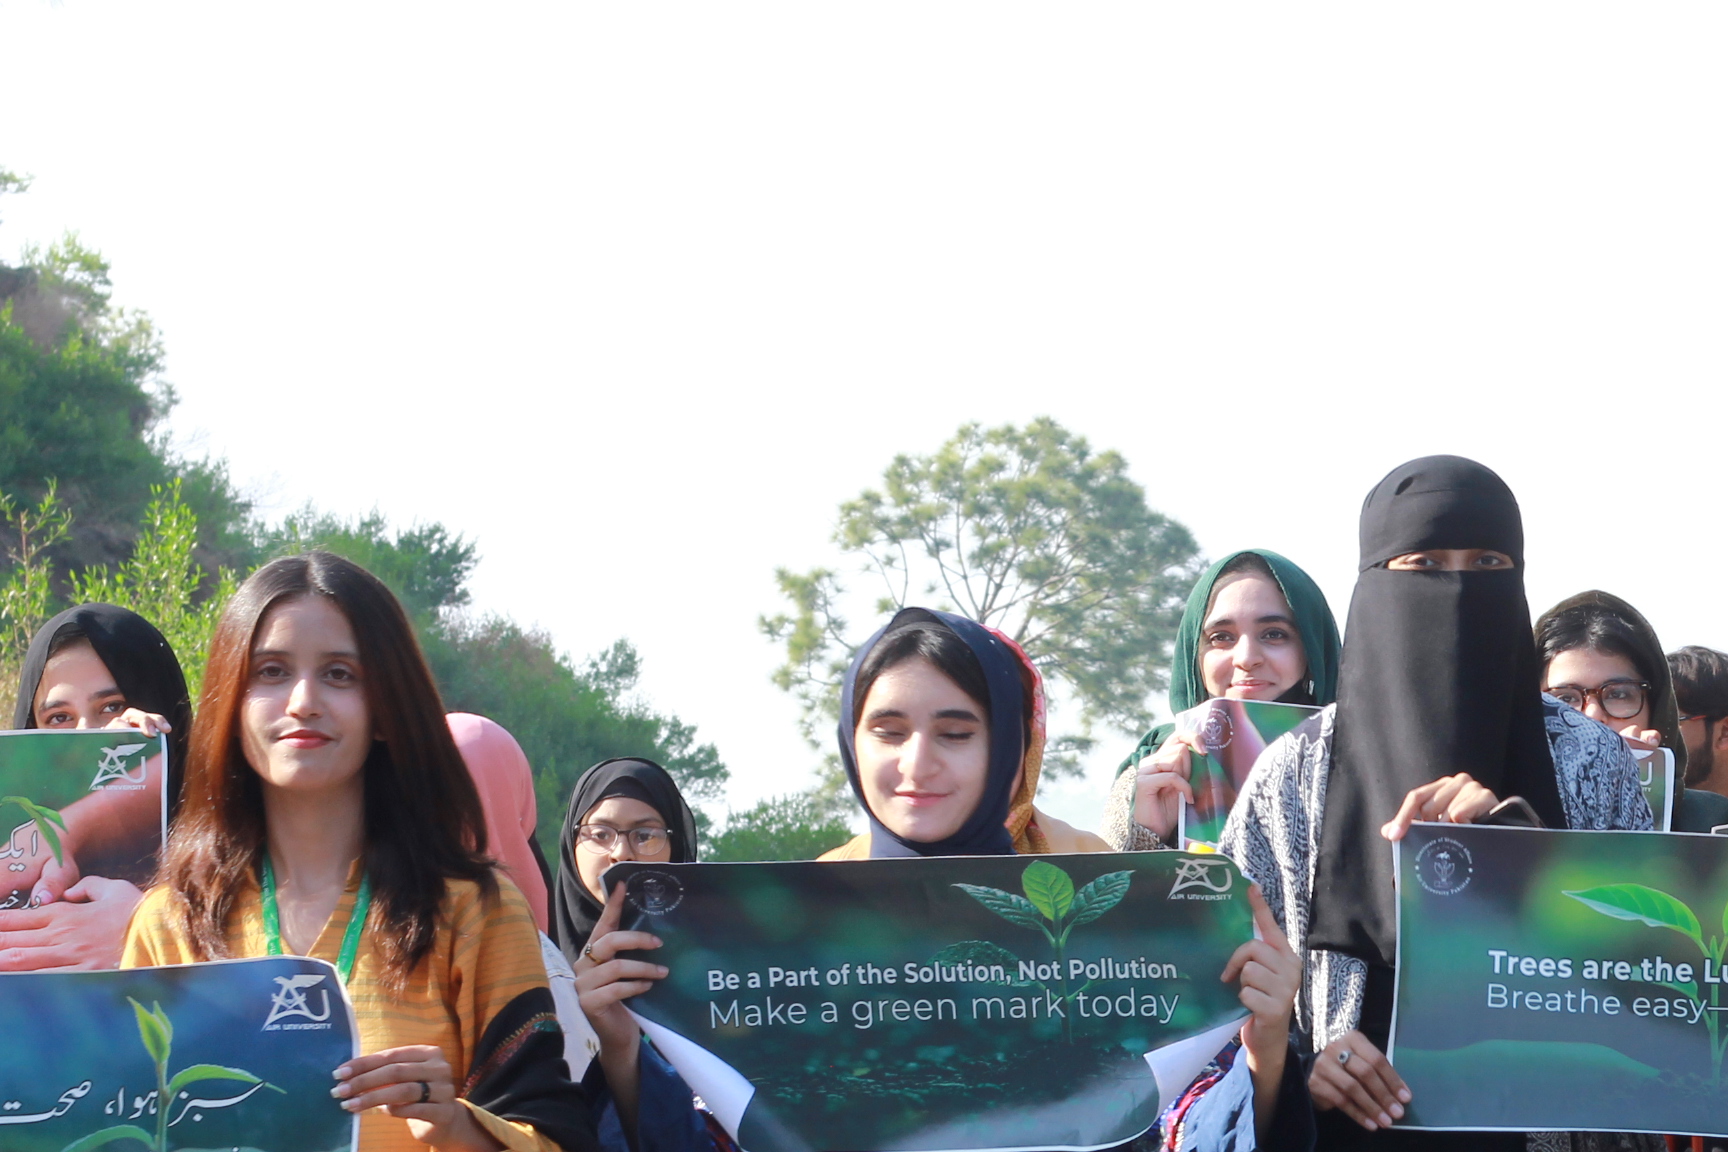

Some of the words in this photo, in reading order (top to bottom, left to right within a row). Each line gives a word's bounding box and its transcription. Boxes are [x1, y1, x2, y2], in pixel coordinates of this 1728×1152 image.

[1187, 893, 1233, 901] UNIVERSITY
[707, 969, 740, 991] Be
[747, 972, 761, 989] a
[768, 967, 820, 988] Part
[826, 963, 851, 985] of
[856, 963, 898, 985] the
[903, 959, 1012, 985] Solution,
[1018, 960, 1063, 981] Not
[1069, 957, 1178, 980] Pollution
[1487, 949, 1573, 979] Trees
[1582, 959, 1632, 981] are
[1640, 956, 1694, 983] the
[709, 996, 808, 1029] Make
[820, 1000, 839, 1024] a
[851, 998, 957, 1030] green
[971, 988, 1066, 1020] mark
[1075, 987, 1180, 1024] today
[1487, 982, 1621, 1016] Breathe
[282, 1022, 333, 1031] UNIVERSITY
[167, 1080, 265, 1128] سبز
